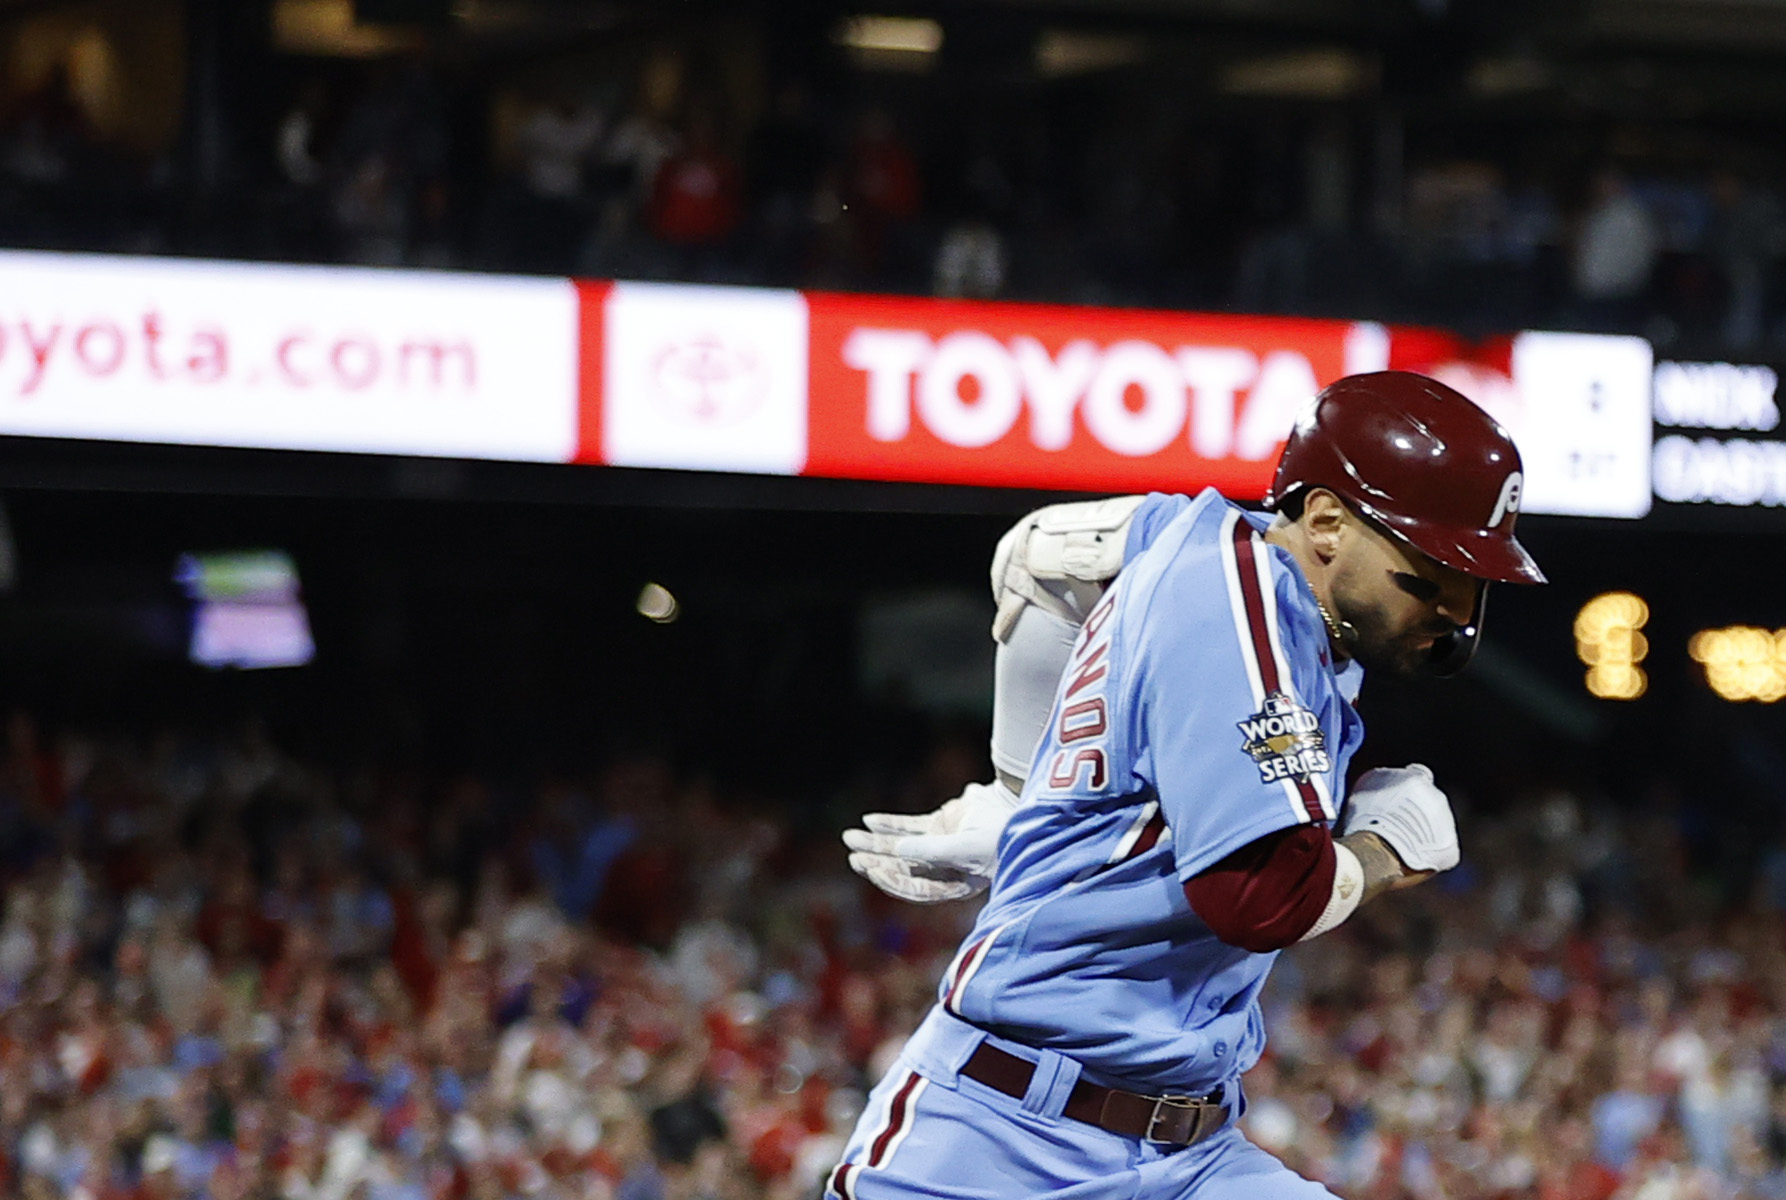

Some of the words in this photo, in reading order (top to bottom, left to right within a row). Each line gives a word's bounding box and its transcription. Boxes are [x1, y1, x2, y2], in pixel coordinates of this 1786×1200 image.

[0, 308, 478, 396] yota.com
[844, 327, 1320, 460] TOYOTA
[1487, 471, 1522, 528] P
[1238, 712, 1319, 741] WORLD
[1259, 750, 1329, 781] SERIES
